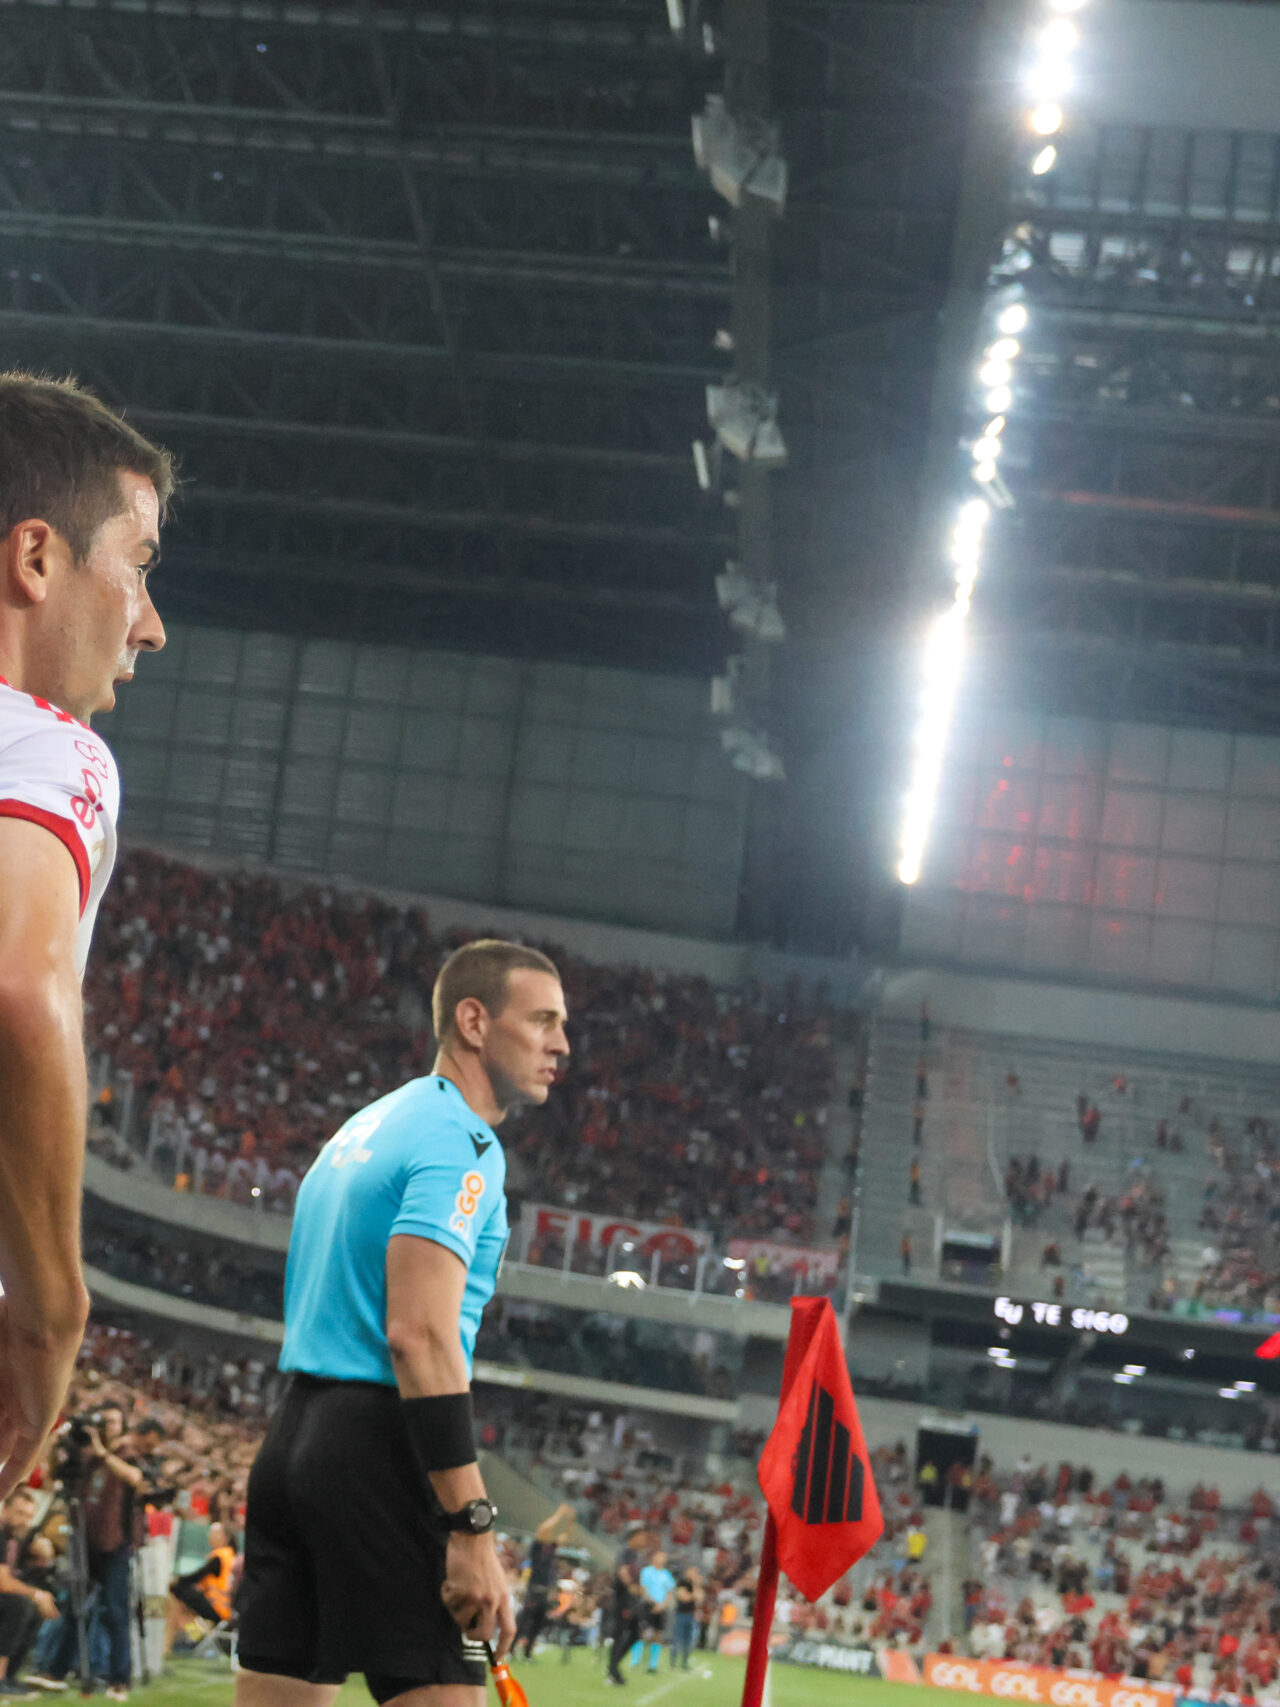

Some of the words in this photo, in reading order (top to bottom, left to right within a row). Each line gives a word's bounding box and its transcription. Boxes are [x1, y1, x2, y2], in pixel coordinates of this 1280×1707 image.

[1032, 1302, 1062, 1326] TE
[1071, 1308, 1129, 1334] SIGO
[931, 1662, 983, 1692] GOL
[990, 1671, 1042, 1700] GOL
